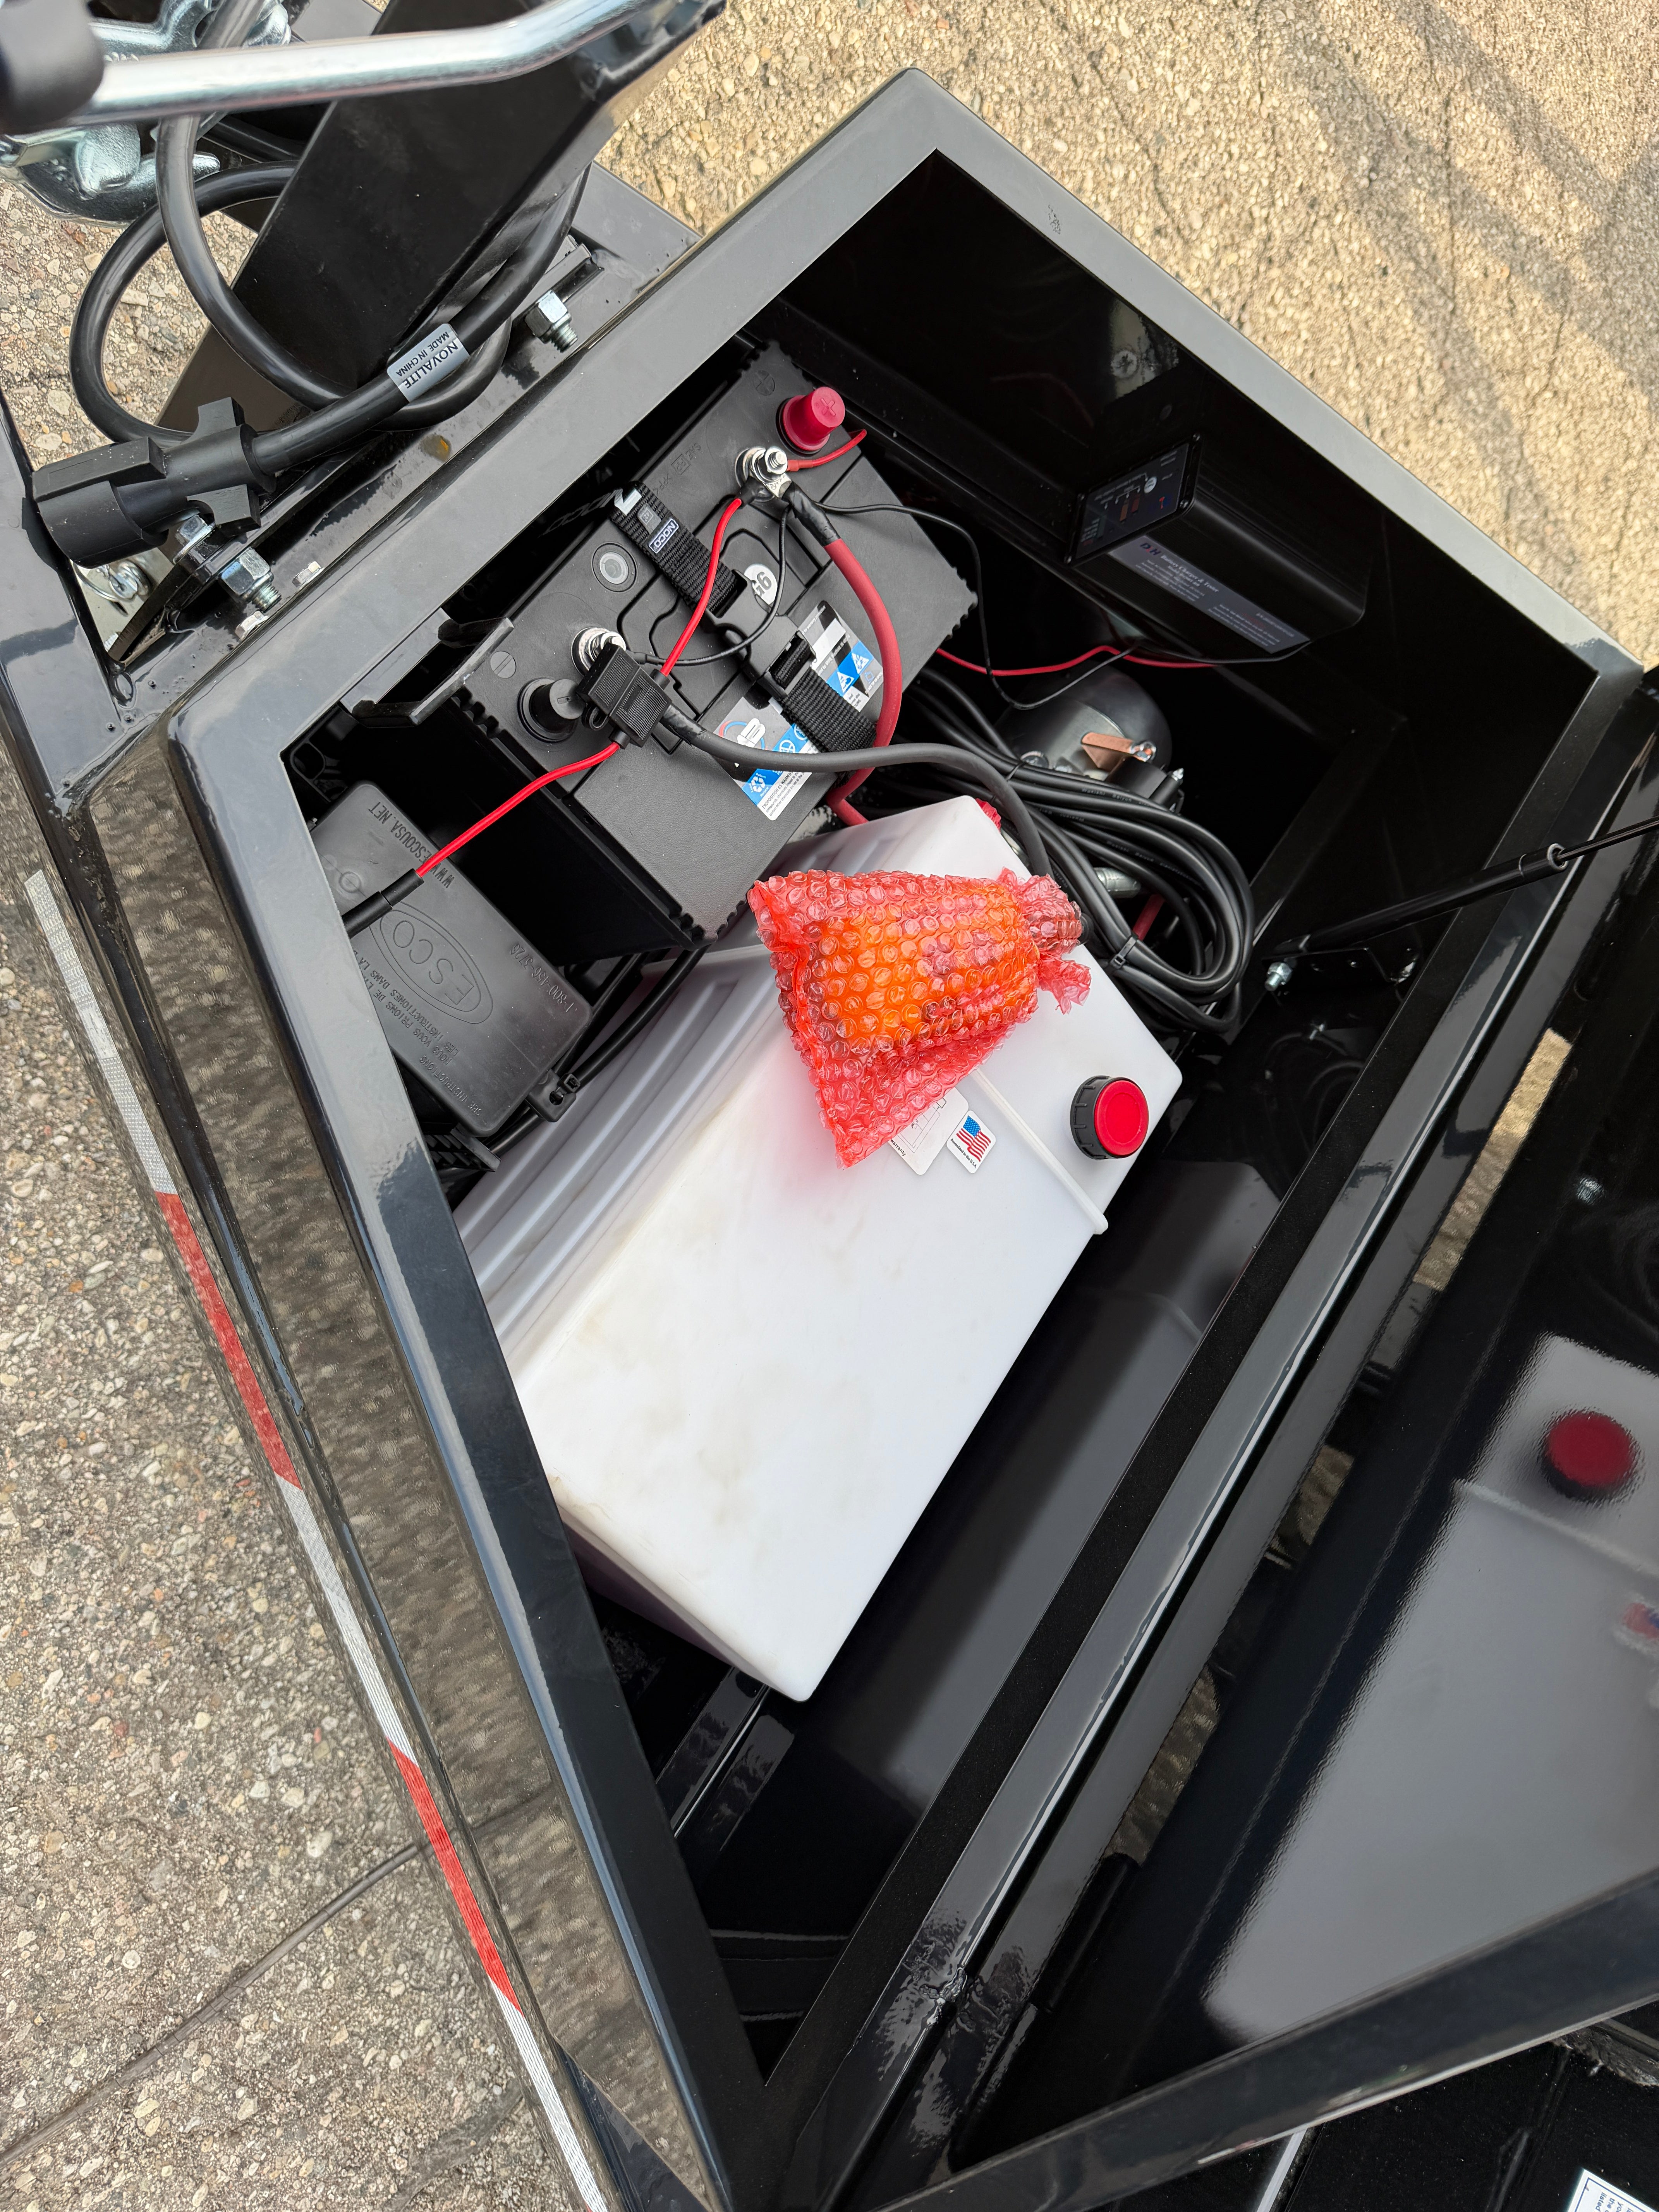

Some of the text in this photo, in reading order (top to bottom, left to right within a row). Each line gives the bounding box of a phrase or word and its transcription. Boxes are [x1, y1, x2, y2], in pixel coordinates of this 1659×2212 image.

[395, 331, 450, 377] MADE IN CHINA
[402, 340, 459, 388] NOVALITE
[652, 522, 676, 547] NOCO
[761, 788, 779, 809] PROPOSITION
[368, 799, 455, 888] WWWESCOUSA.NET
[357, 957, 371, 969] LA
[394, 920, 474, 1006] ESCO
[369, 969, 390, 989] DANS
[373, 989, 452, 1065] NOUS VOUS PRIONS DE
[442, 1041, 459, 1058] LES
[417, 1054, 470, 1104] INSTRUCTIONS
[890, 1137, 907, 1156] warranty
[950, 1138, 965, 1154] Assembled
[1595, 2192, 1607, 2212] listed
